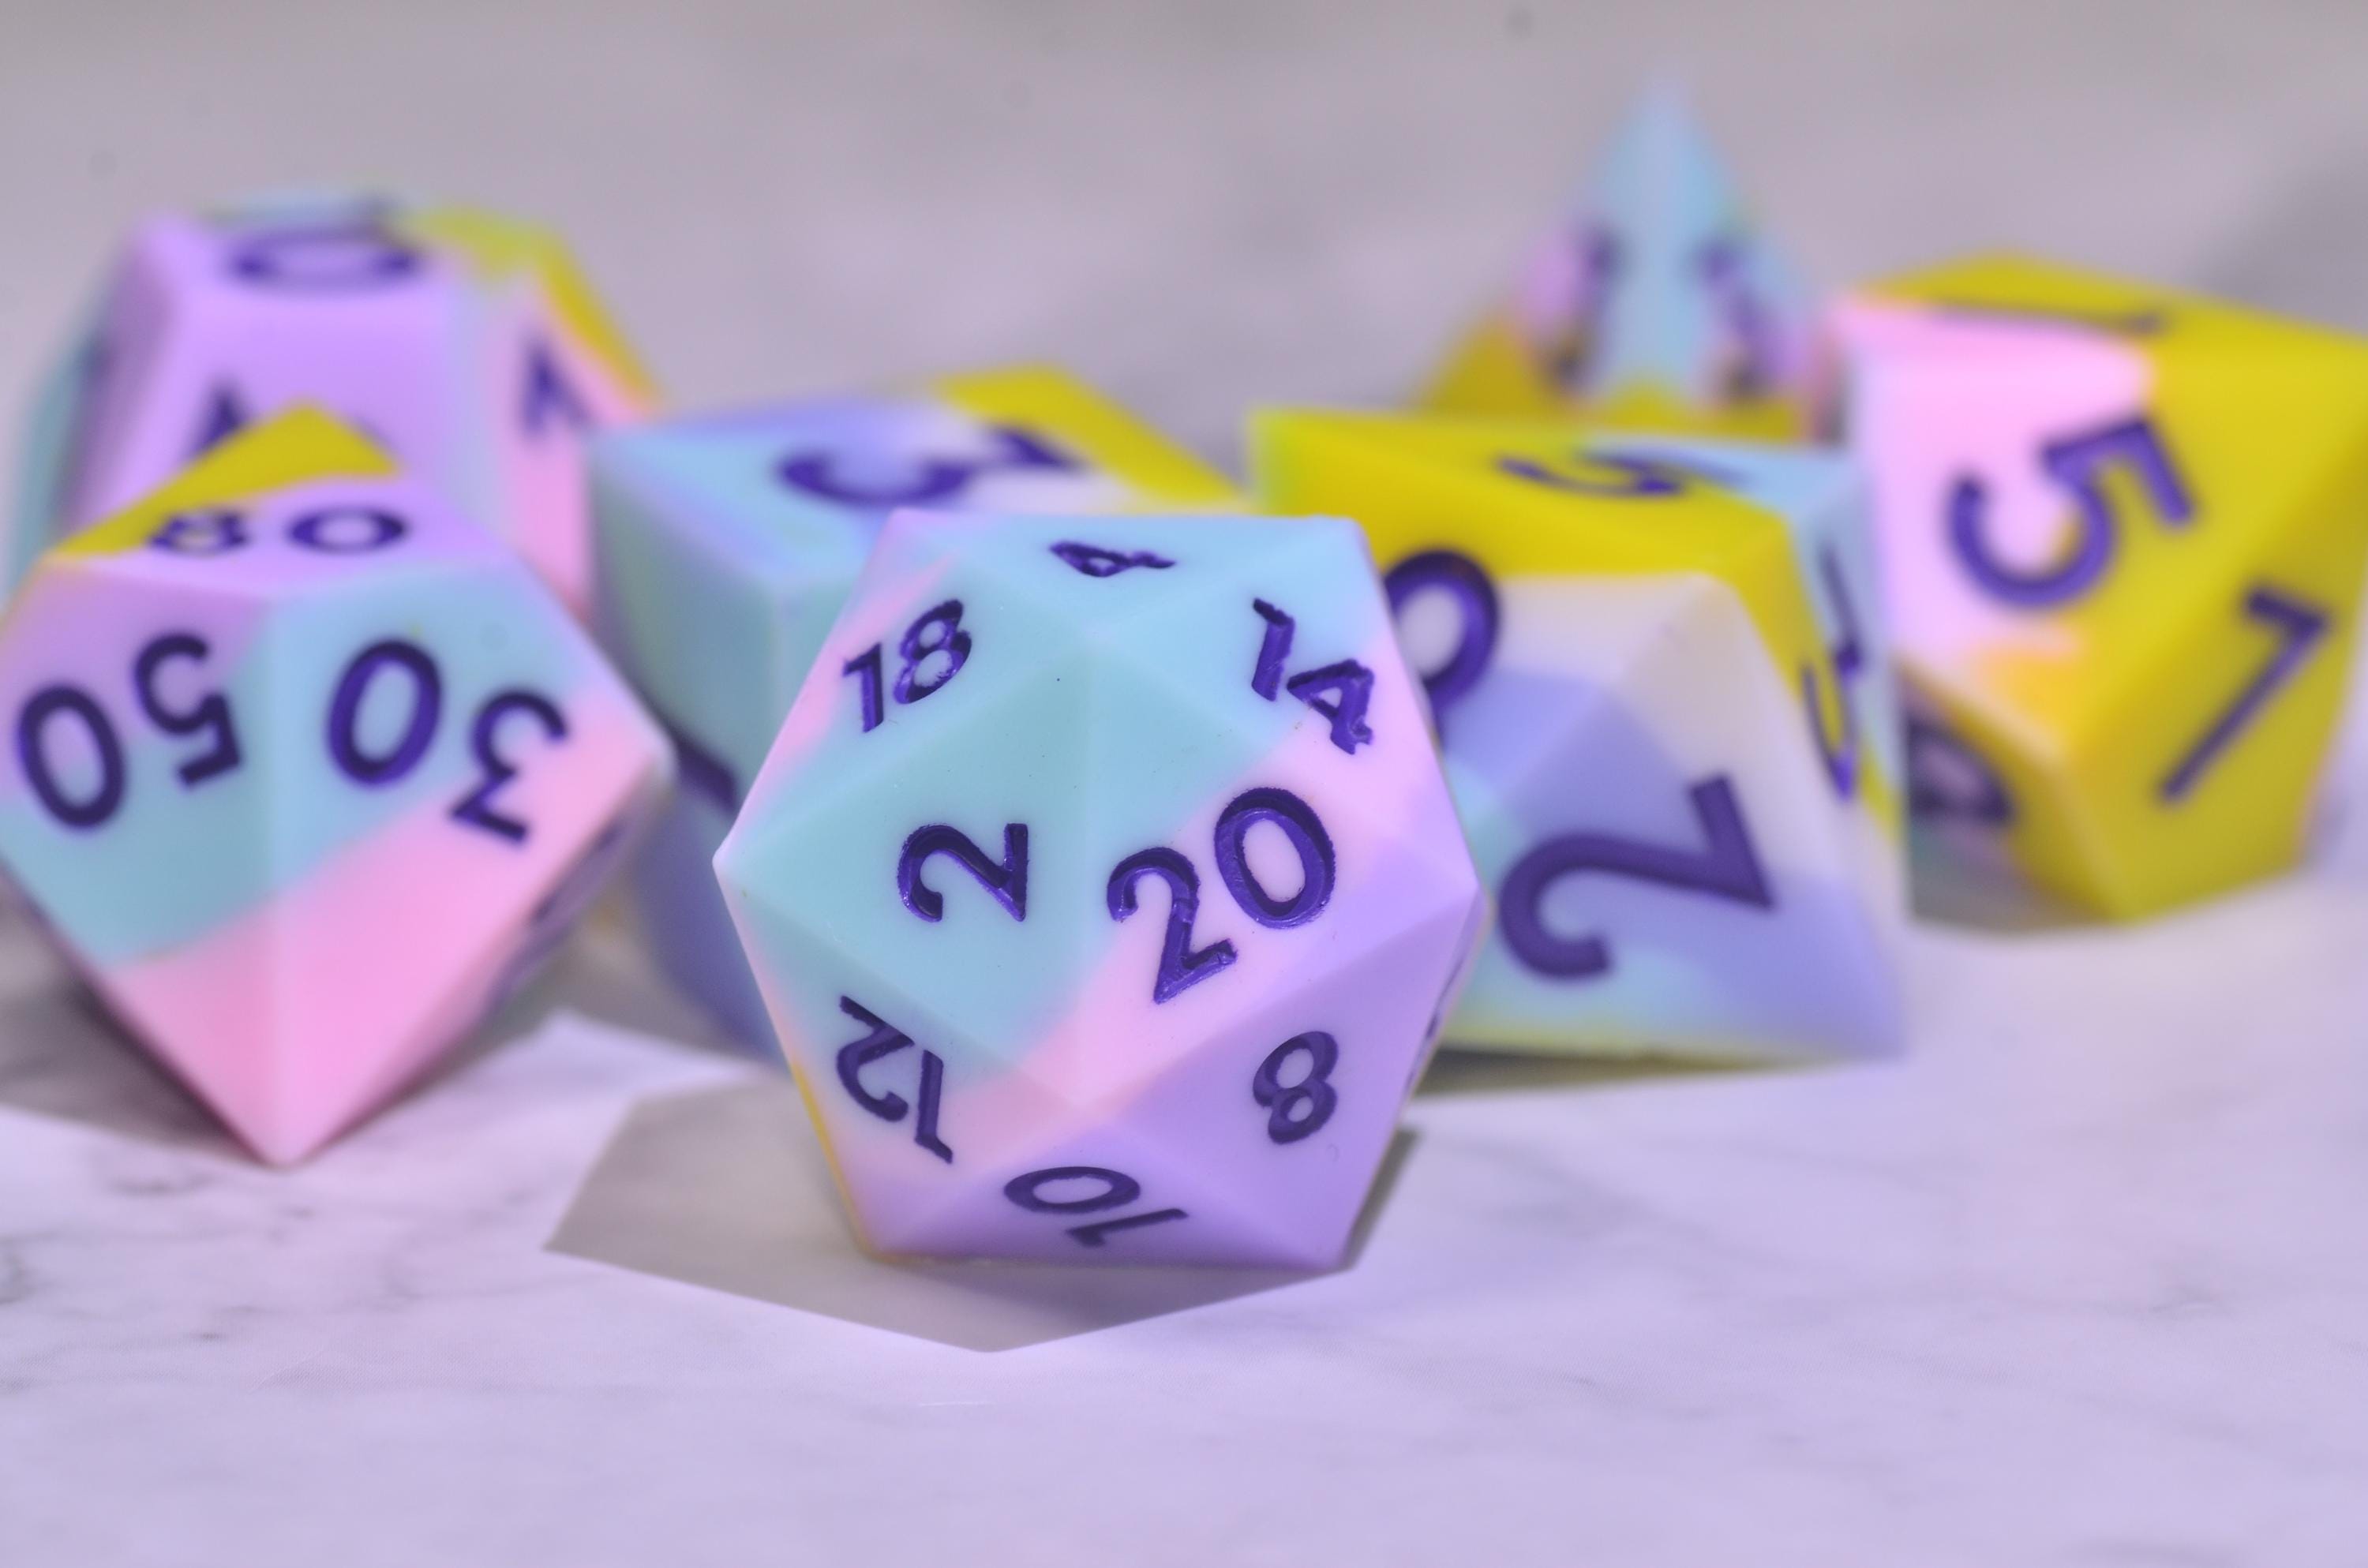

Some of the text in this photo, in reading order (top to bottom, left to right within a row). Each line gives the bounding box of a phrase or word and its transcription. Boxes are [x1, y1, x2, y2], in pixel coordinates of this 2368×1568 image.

[1048, 540, 1175, 578] 4
[1946, 415, 2198, 612] 5
[16, 631, 242, 831] 50
[326, 638, 569, 846] 30
[841, 598, 972, 734] 18
[1252, 597, 1374, 755] 14
[897, 821, 1029, 923] 2
[1106, 786, 1337, 1005] 20
[1497, 769, 1778, 985] 2
[836, 994, 954, 1164] 12
[1253, 1030, 1339, 1146] 8
[1002, 1165, 1190, 1248] 10
